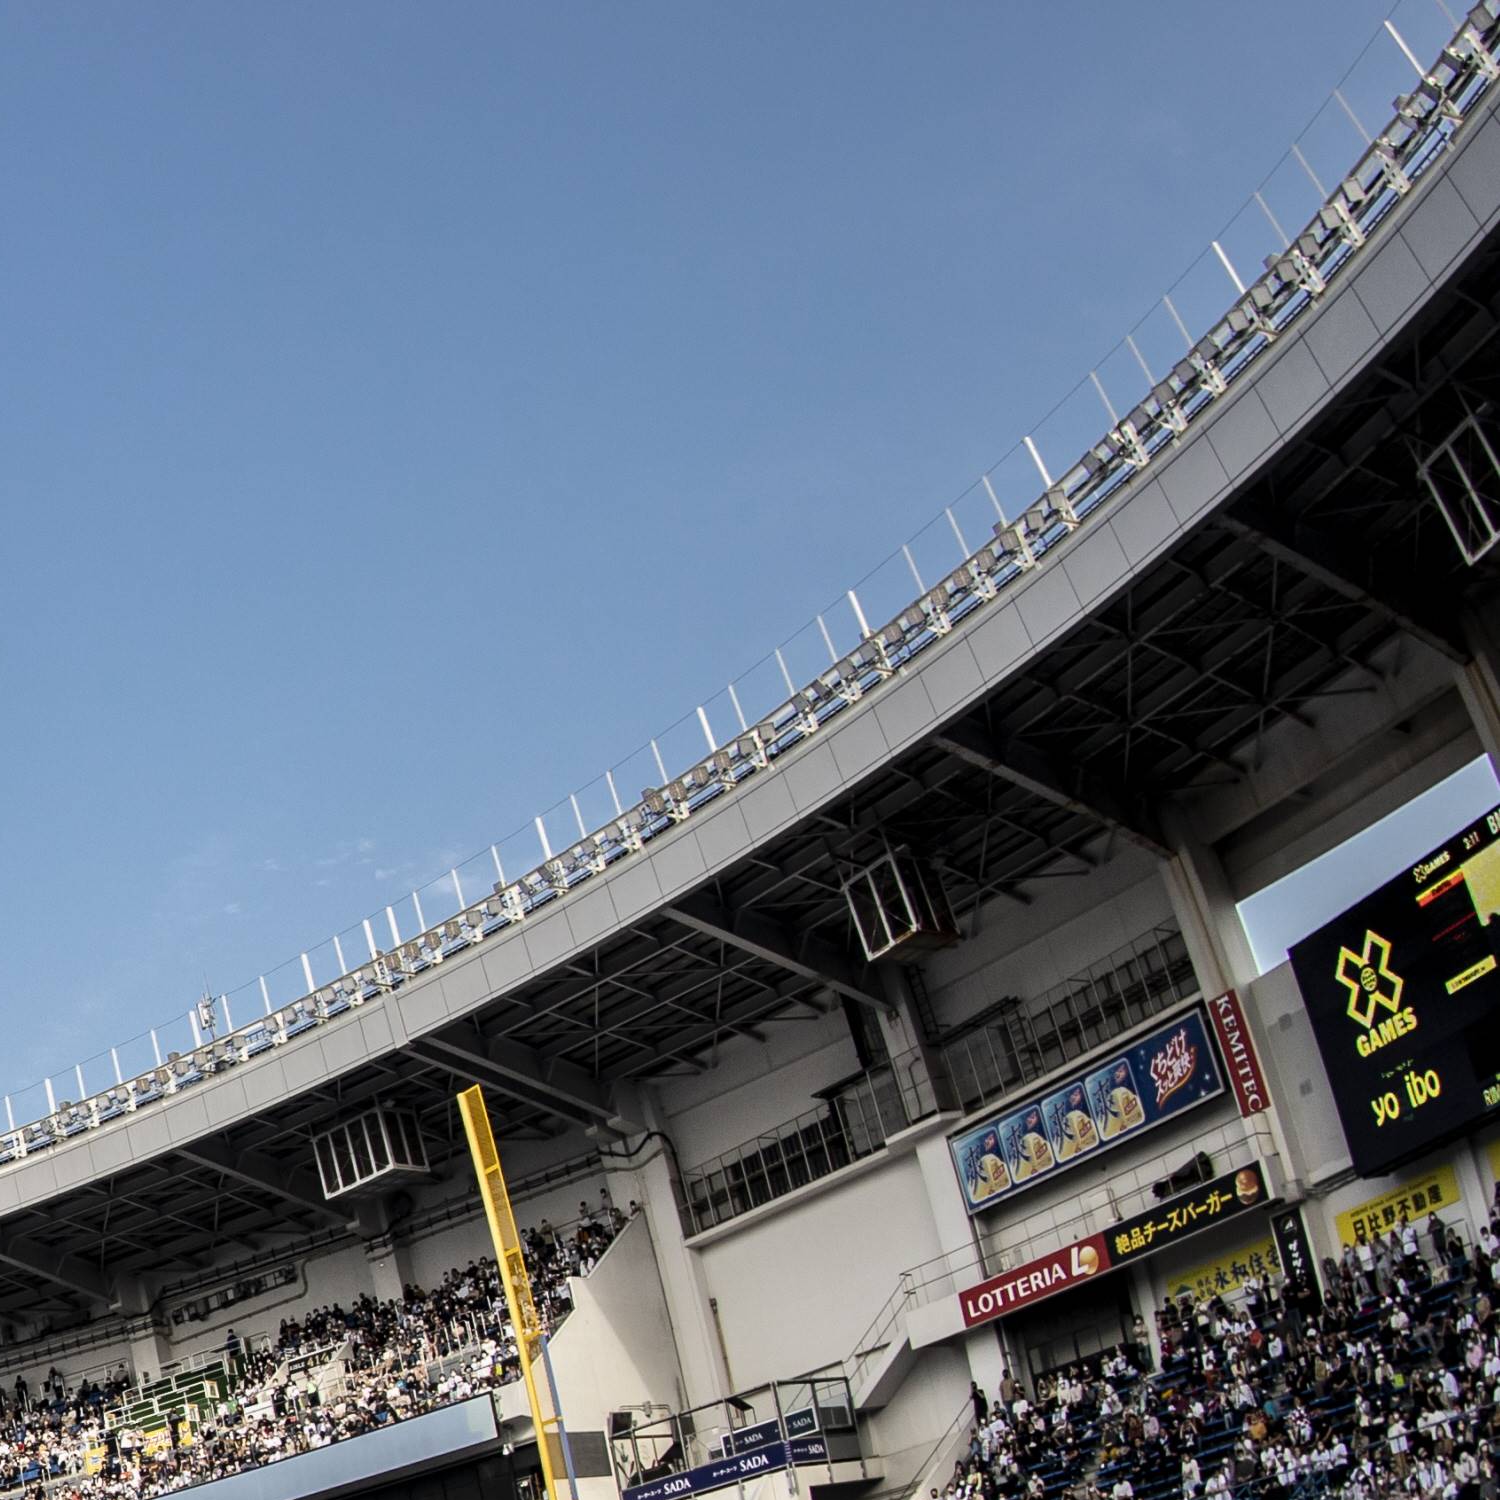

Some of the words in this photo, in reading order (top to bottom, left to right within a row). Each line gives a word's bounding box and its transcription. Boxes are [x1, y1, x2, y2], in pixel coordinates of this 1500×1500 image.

[1216, 994, 1263, 1113] KEMITEC
[1356, 1006, 1418, 1058] GAMES
[1371, 1069, 1441, 1127] yoibo
[1114, 1190, 1233, 1256] 絶品チーズバーガー
[1352, 1183, 1443, 1237] 日比野不動産
[967, 1264, 1067, 1318] LOTTERIA
[739, 1453, 770, 1473] SADA
[743, 1431, 764, 1446] SADA
[807, 1444, 825, 1455] SADA
[663, 1477, 692, 1496] SADA
